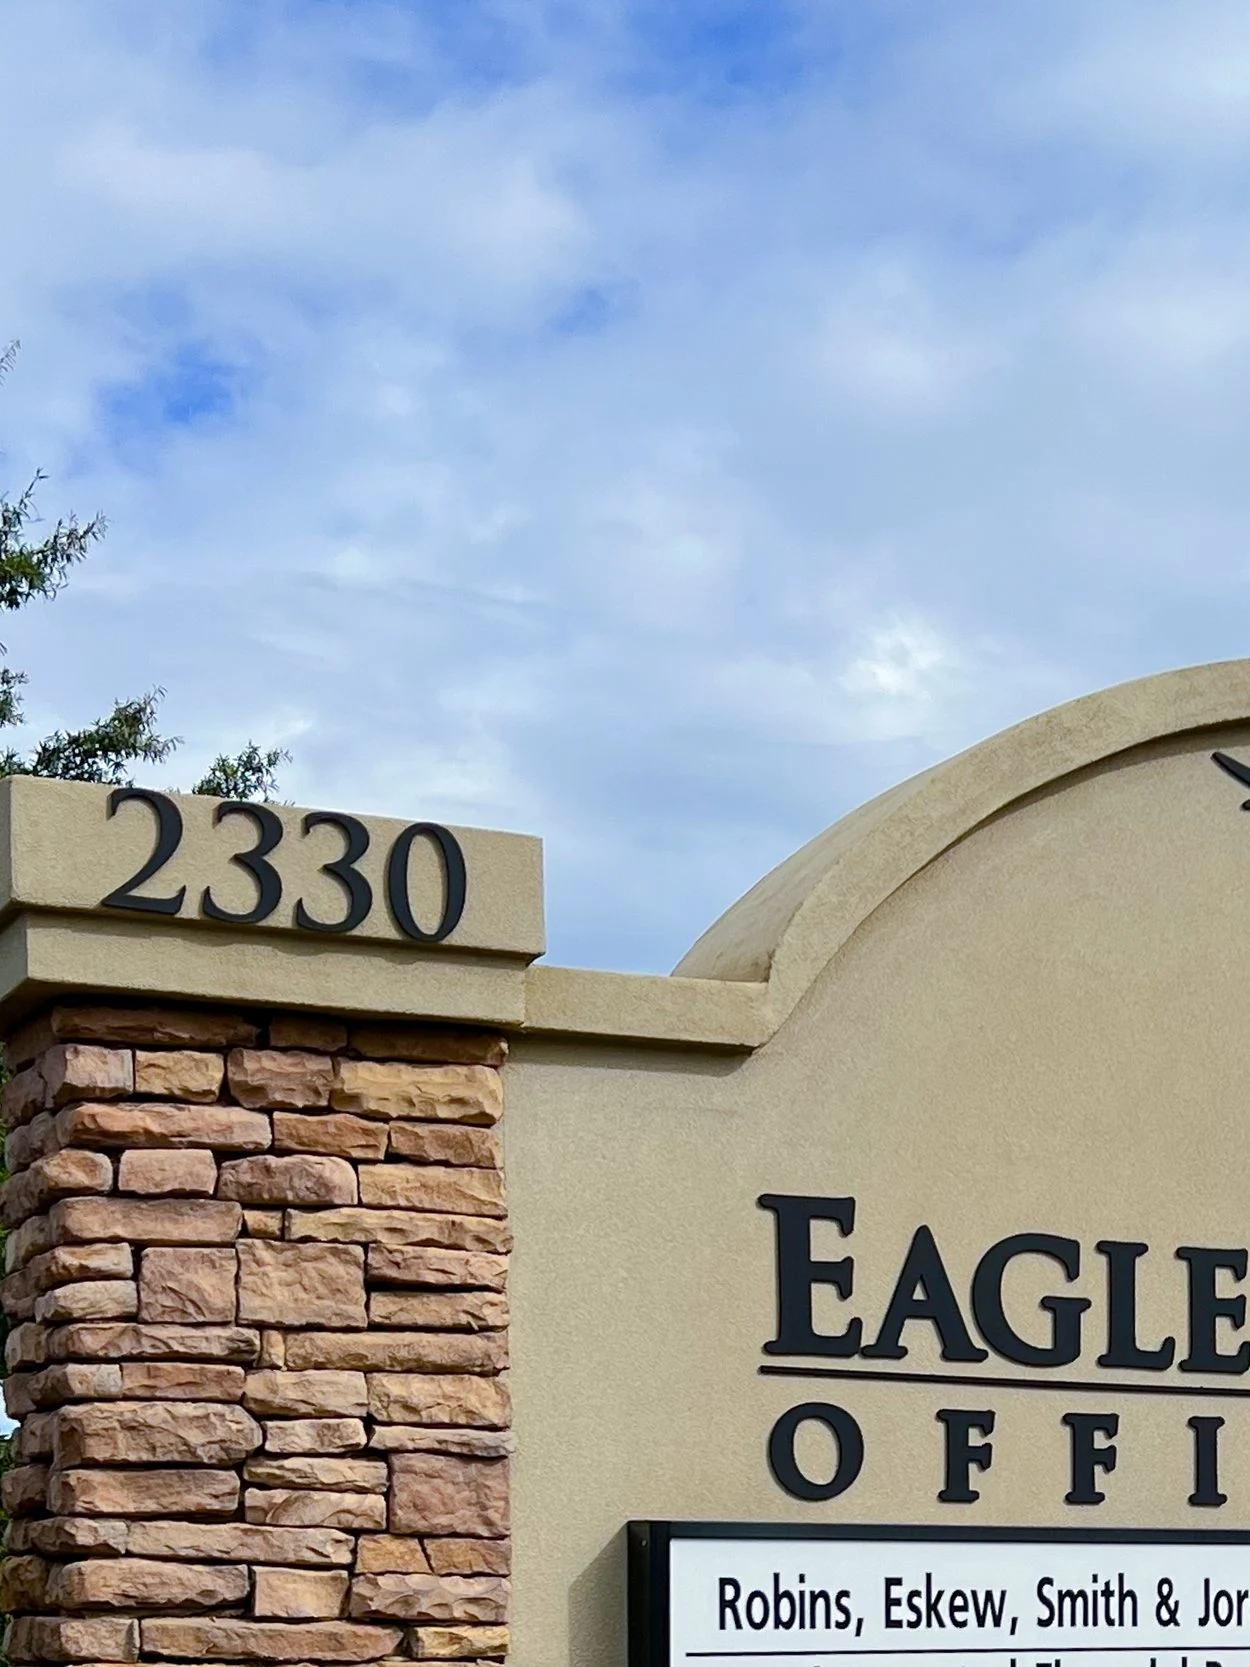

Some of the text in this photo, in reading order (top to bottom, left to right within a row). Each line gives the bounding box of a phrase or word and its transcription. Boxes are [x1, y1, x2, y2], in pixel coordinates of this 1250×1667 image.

[100, 787, 468, 944] 2330
[719, 1573, 863, 1636] Robins,
[885, 1573, 1018, 1635] Eskew,
[1037, 1573, 1137, 1627] Smith
[1156, 1578, 1180, 1627] &
